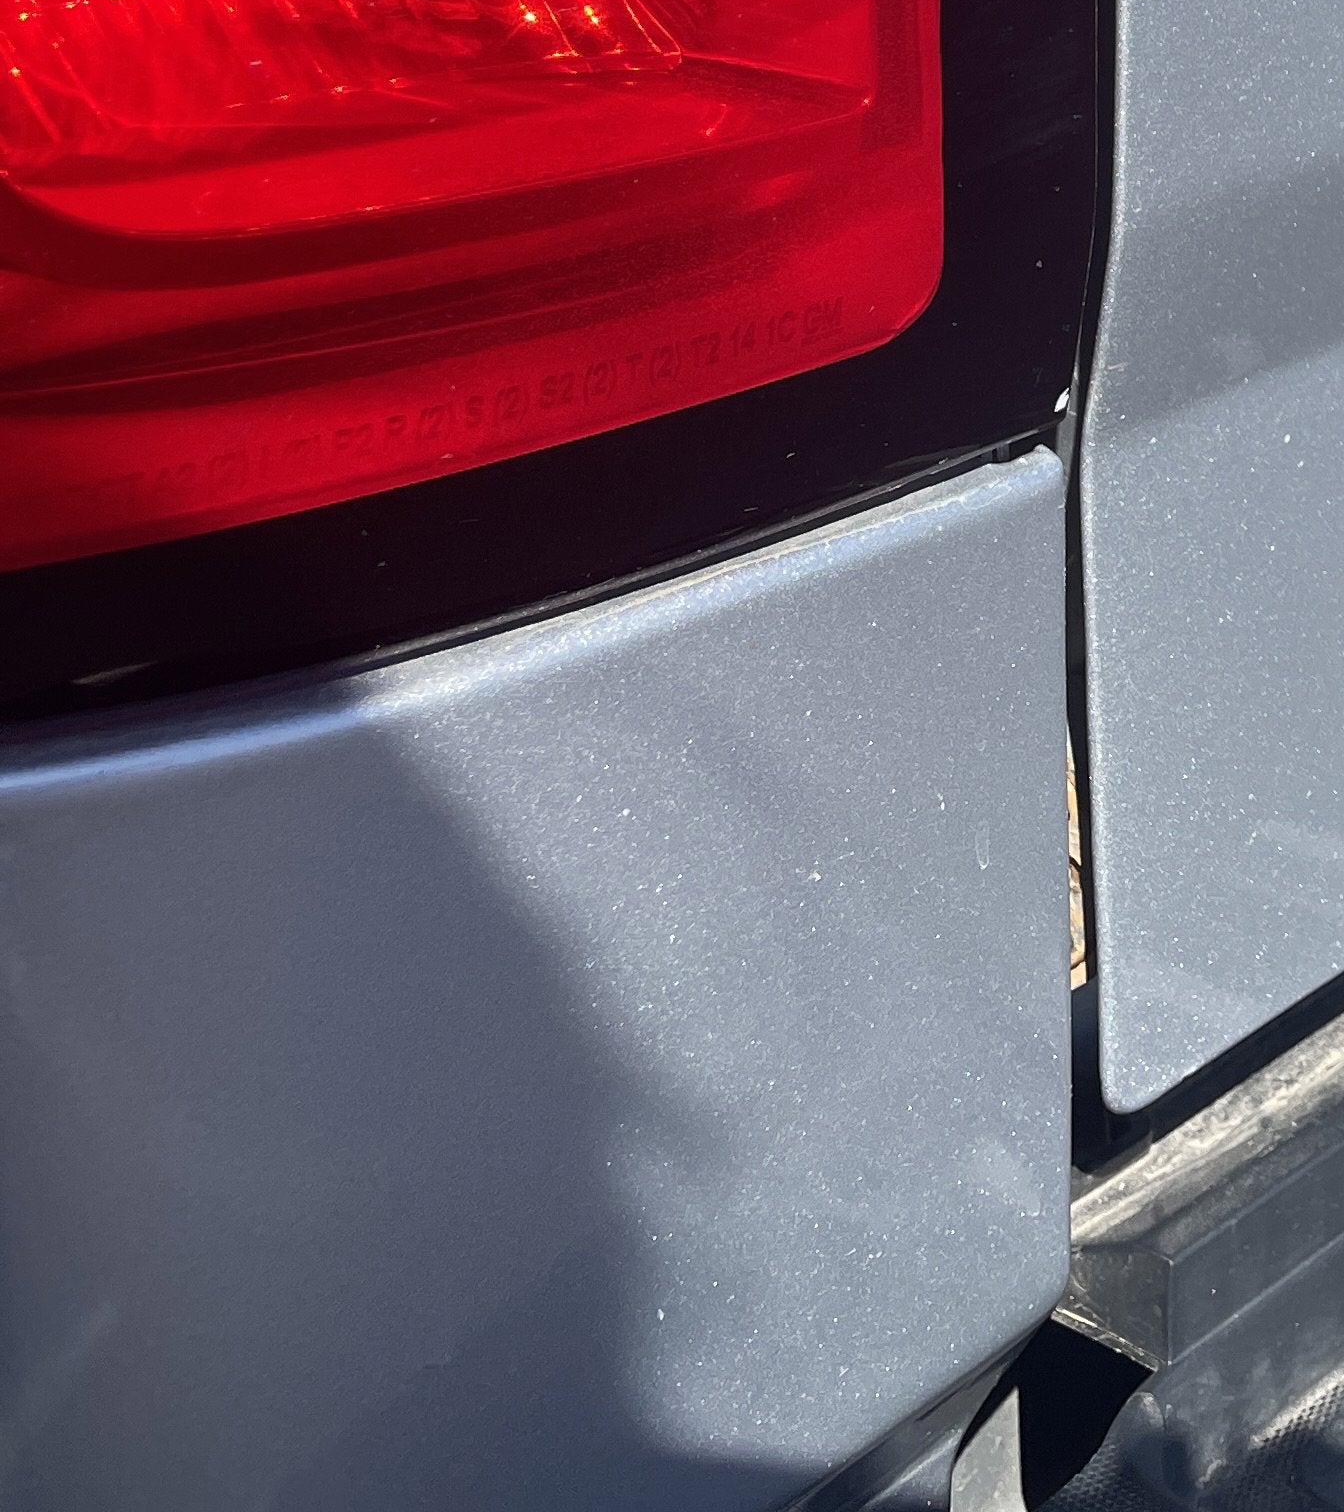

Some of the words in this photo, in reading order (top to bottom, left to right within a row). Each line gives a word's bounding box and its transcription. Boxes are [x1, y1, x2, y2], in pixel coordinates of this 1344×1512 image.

[464, 392, 483, 431] S
[493, 380, 529, 430] (2)
[583, 356, 617, 406] (2)
[625, 351, 642, 386] T
[649, 340, 681, 388] (2)
